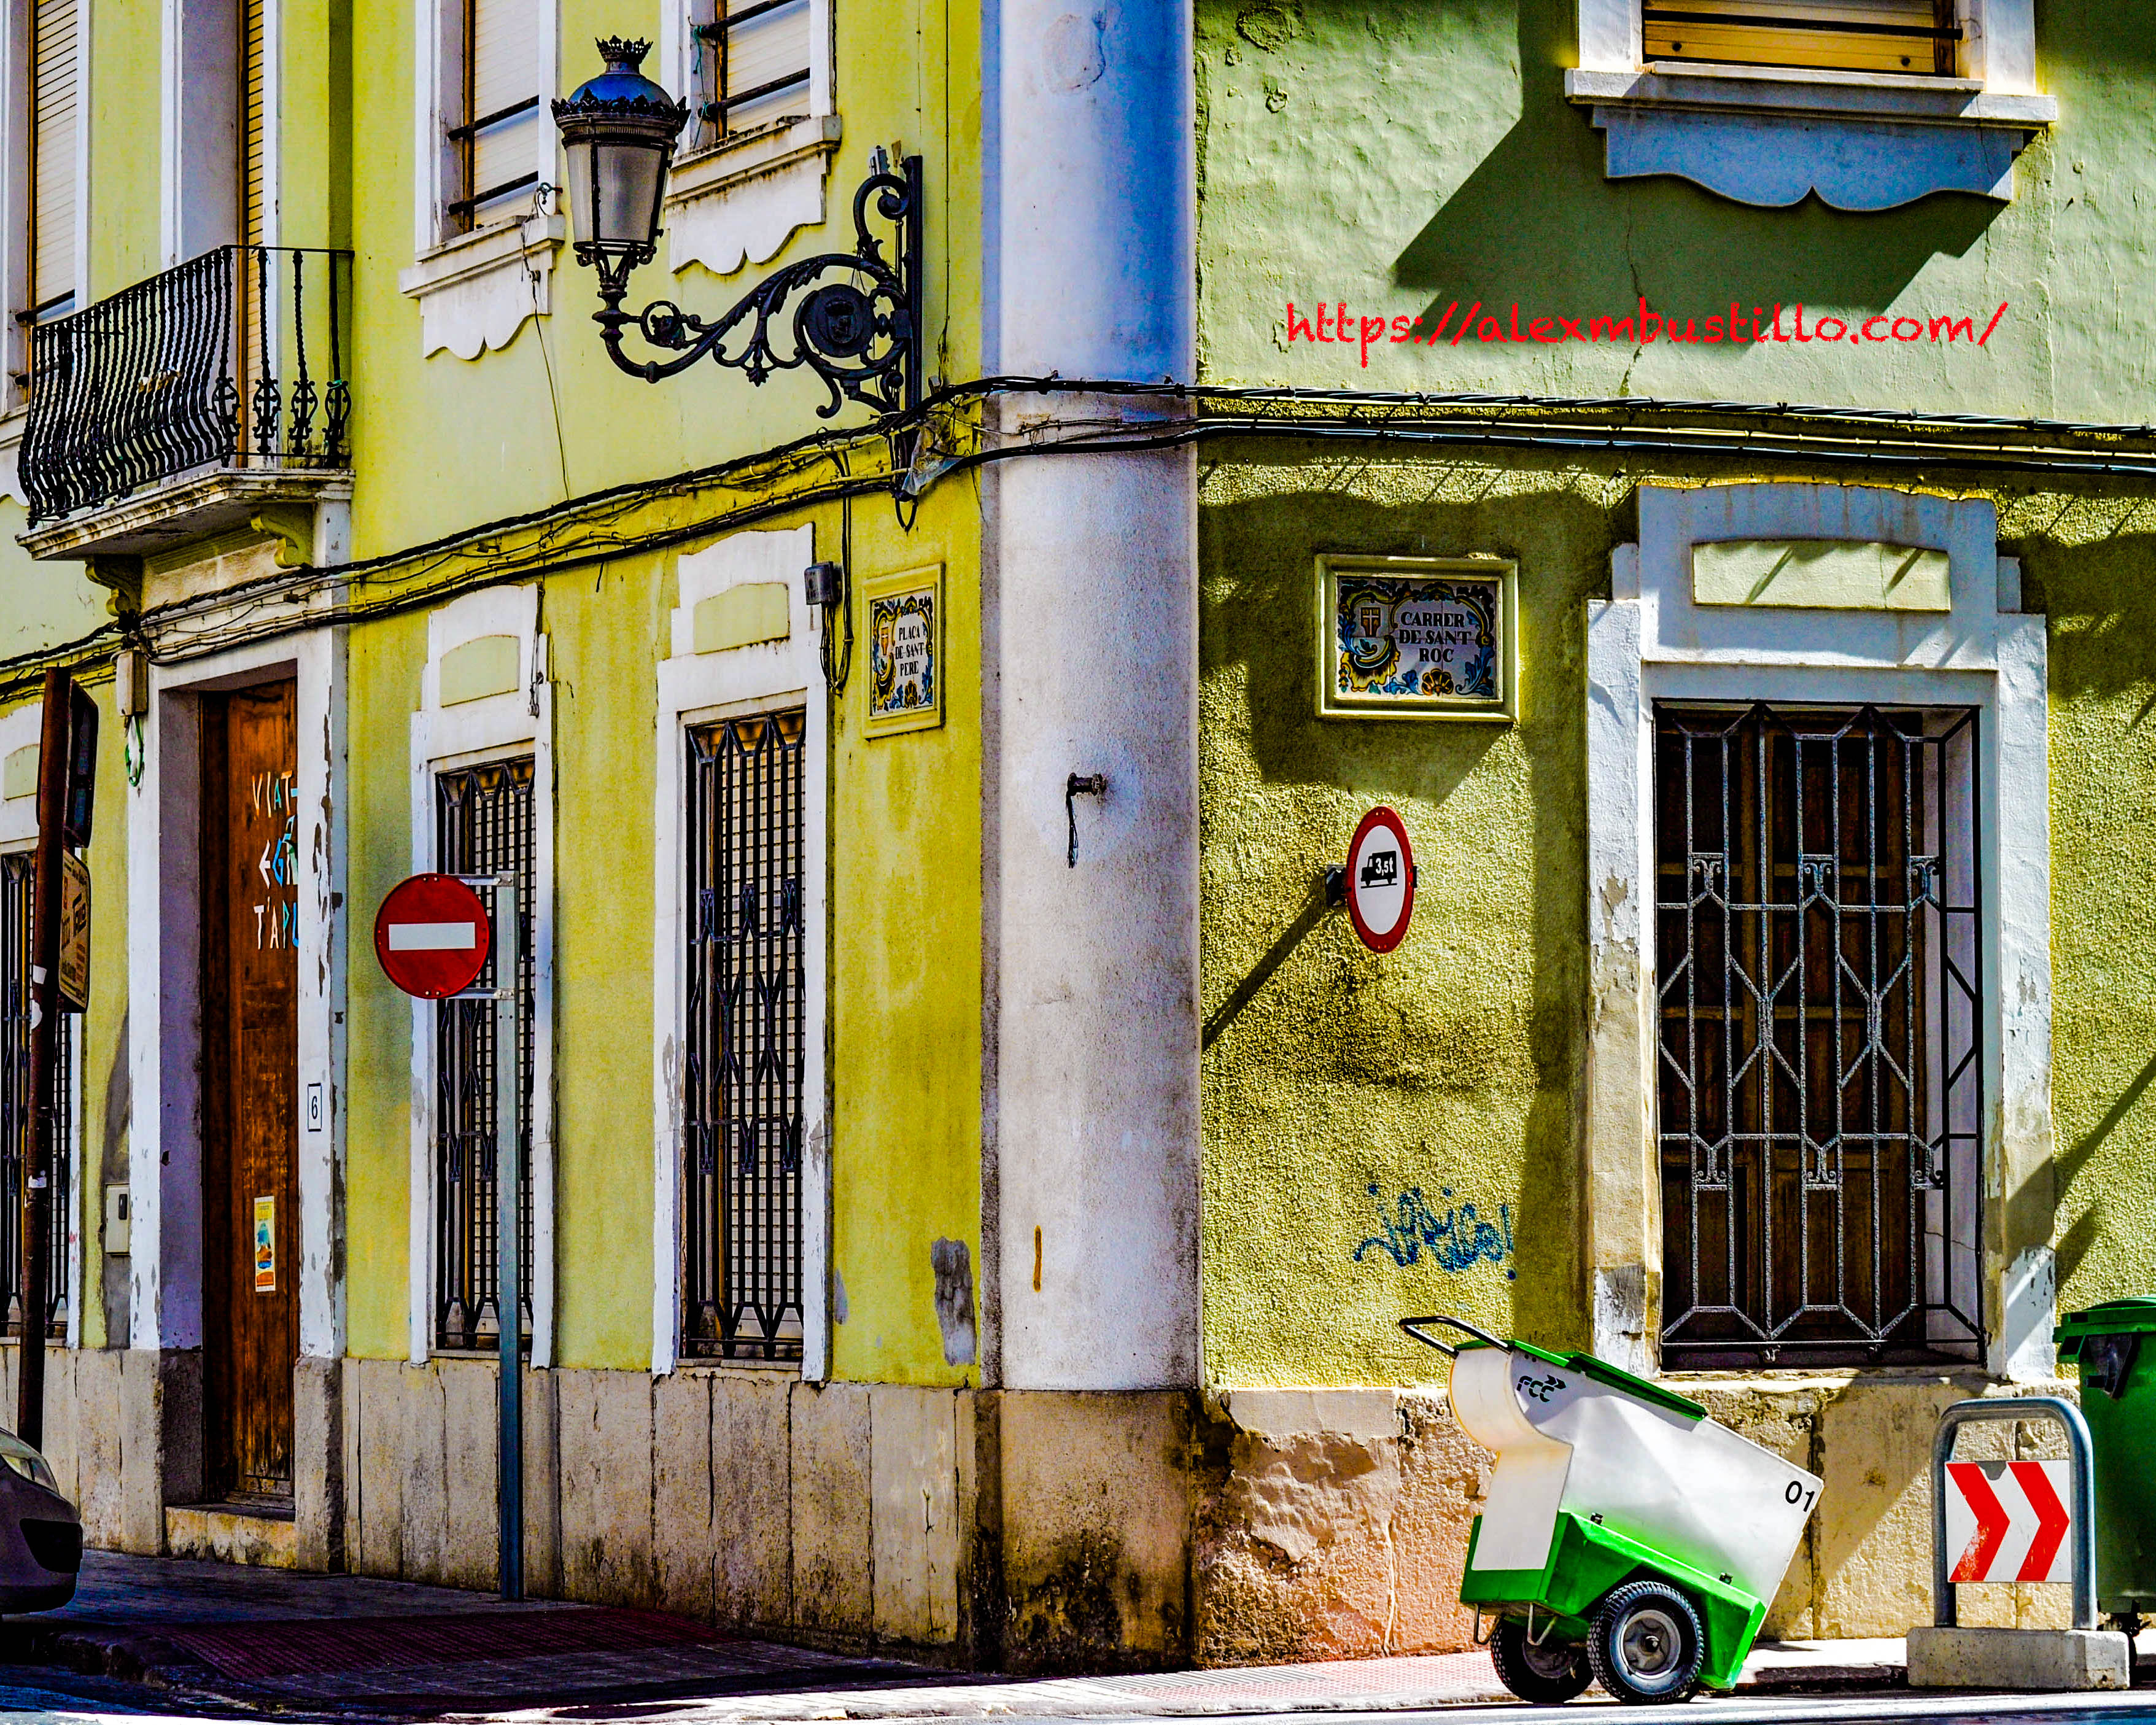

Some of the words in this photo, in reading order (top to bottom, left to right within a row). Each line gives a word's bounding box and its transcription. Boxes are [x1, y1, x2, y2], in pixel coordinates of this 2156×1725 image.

[1400, 611, 1464, 627] CARRER
[1400, 629, 1421, 644] DE
[1425, 630, 1472, 645] SANT
[895, 646, 904, 659] DE
[906, 642, 924, 657] SANT
[1419, 648, 1454, 662] ROC
[900, 661, 918, 676] PERE
[252, 770, 298, 817] VIAT
[1375, 858, 1394, 876] 3,5t
[311, 1095, 318, 1119] 6
[1516, 1375, 1555, 1403] FCC
[1785, 1481, 1815, 1512] 01
